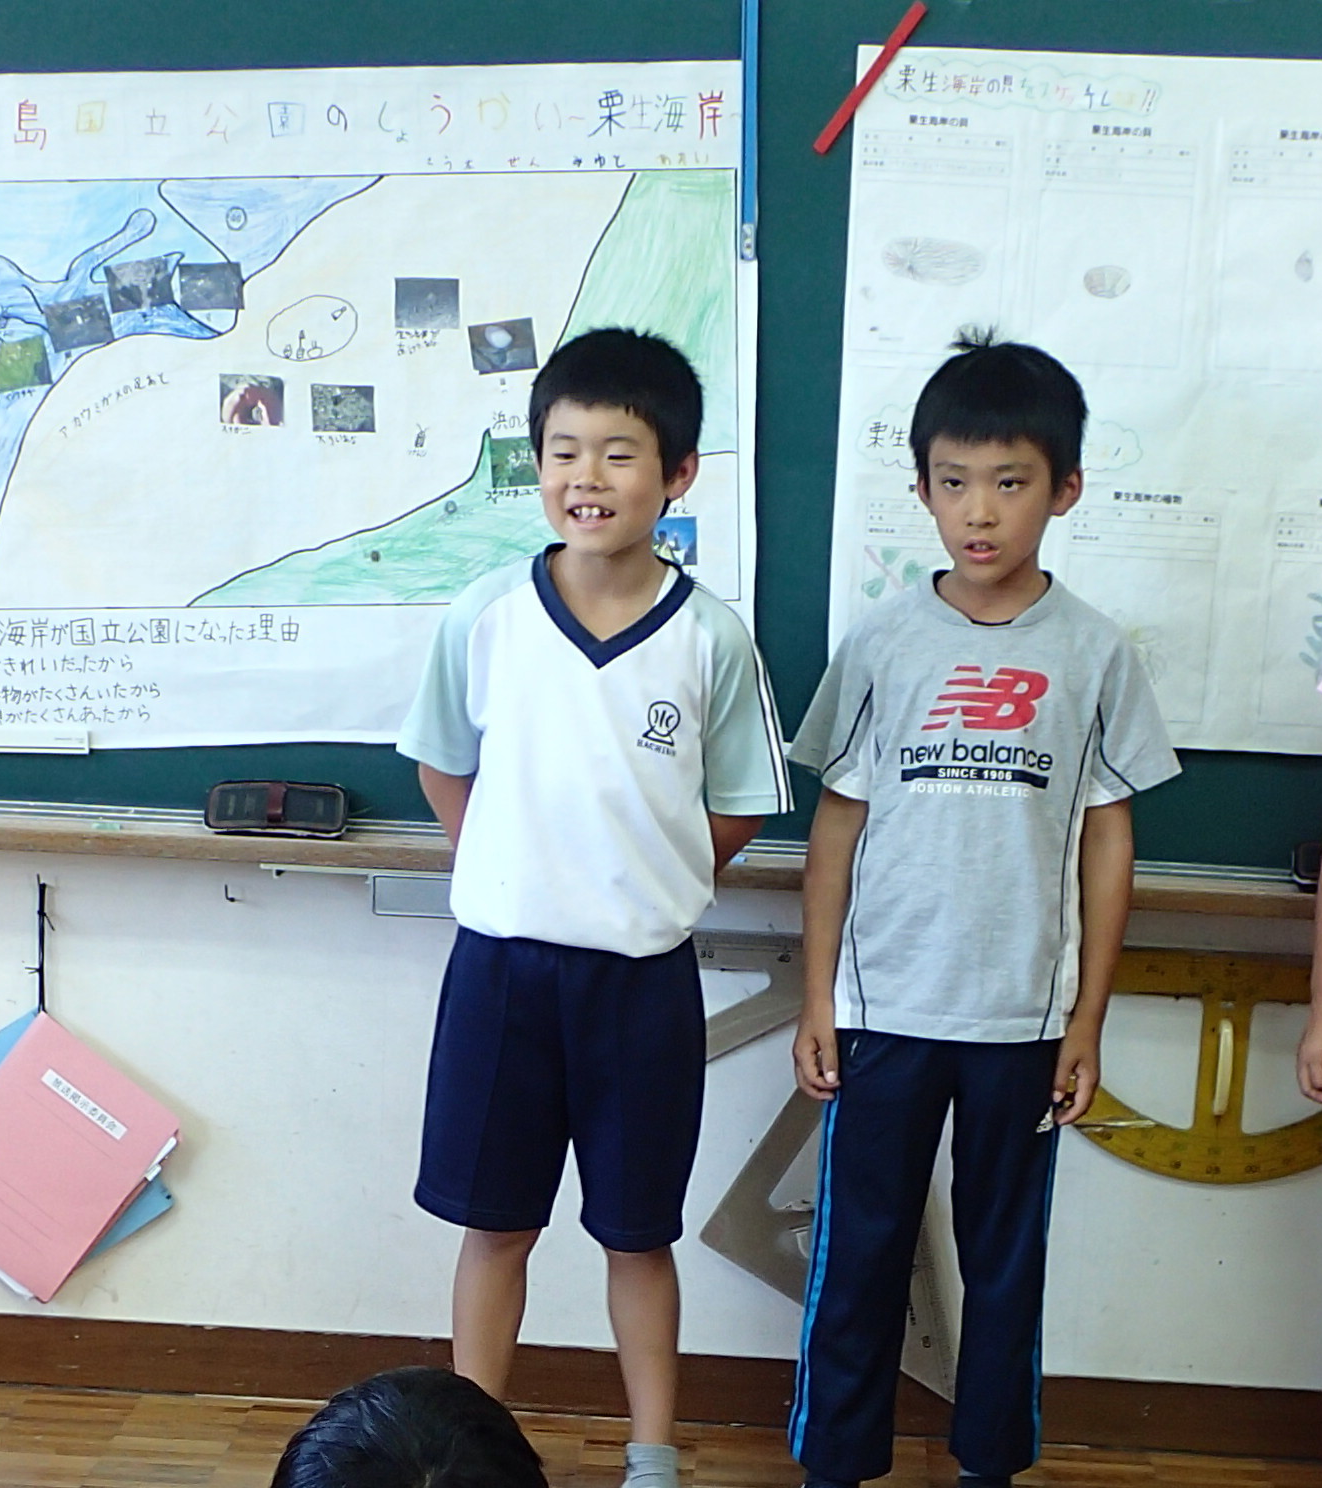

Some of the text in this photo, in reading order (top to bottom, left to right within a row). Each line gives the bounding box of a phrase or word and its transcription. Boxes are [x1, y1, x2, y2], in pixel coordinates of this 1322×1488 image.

[900, 738, 1053, 771] new balance
[937, 768, 1013, 781] SINCE 1906
[908, 783, 1030, 798] BOSTON ATHLETIC
